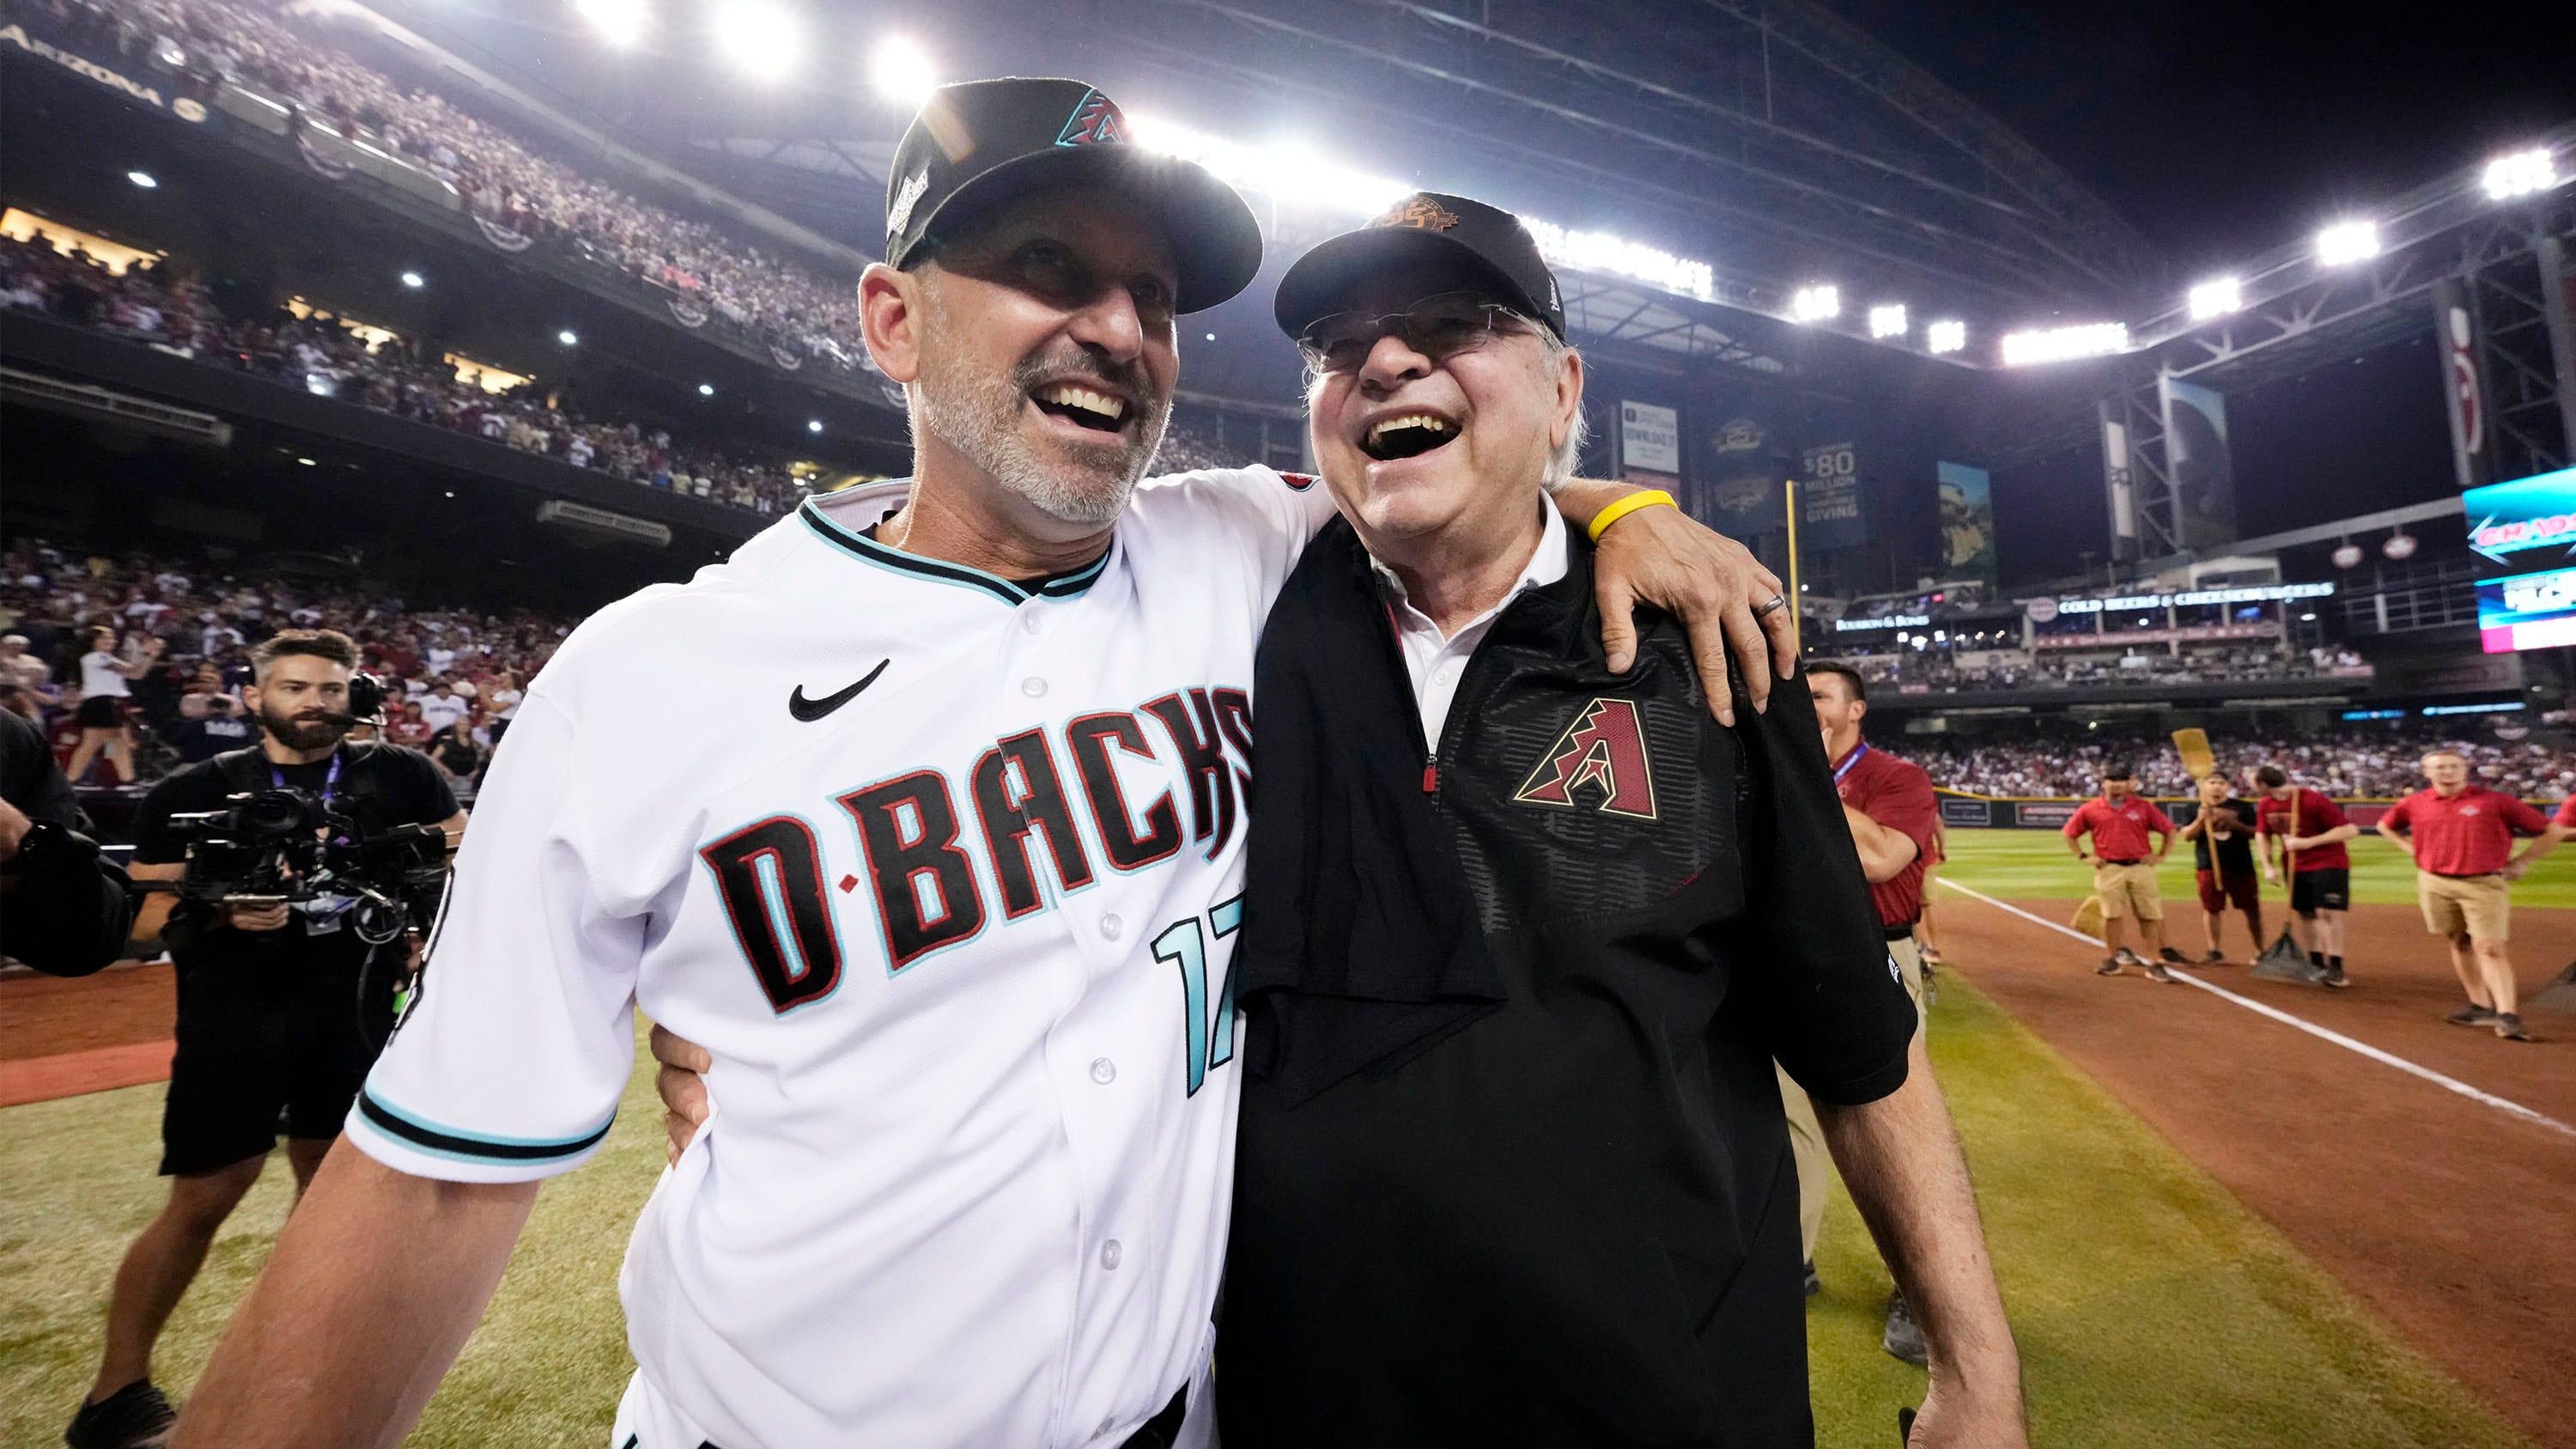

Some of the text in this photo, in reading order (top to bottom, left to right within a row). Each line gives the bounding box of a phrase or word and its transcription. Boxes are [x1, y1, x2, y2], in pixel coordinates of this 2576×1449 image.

[1804, 451, 1855, 478] $80
[1806, 503, 1858, 523] GIVING
[1150, 889, 1247, 1099] 17
